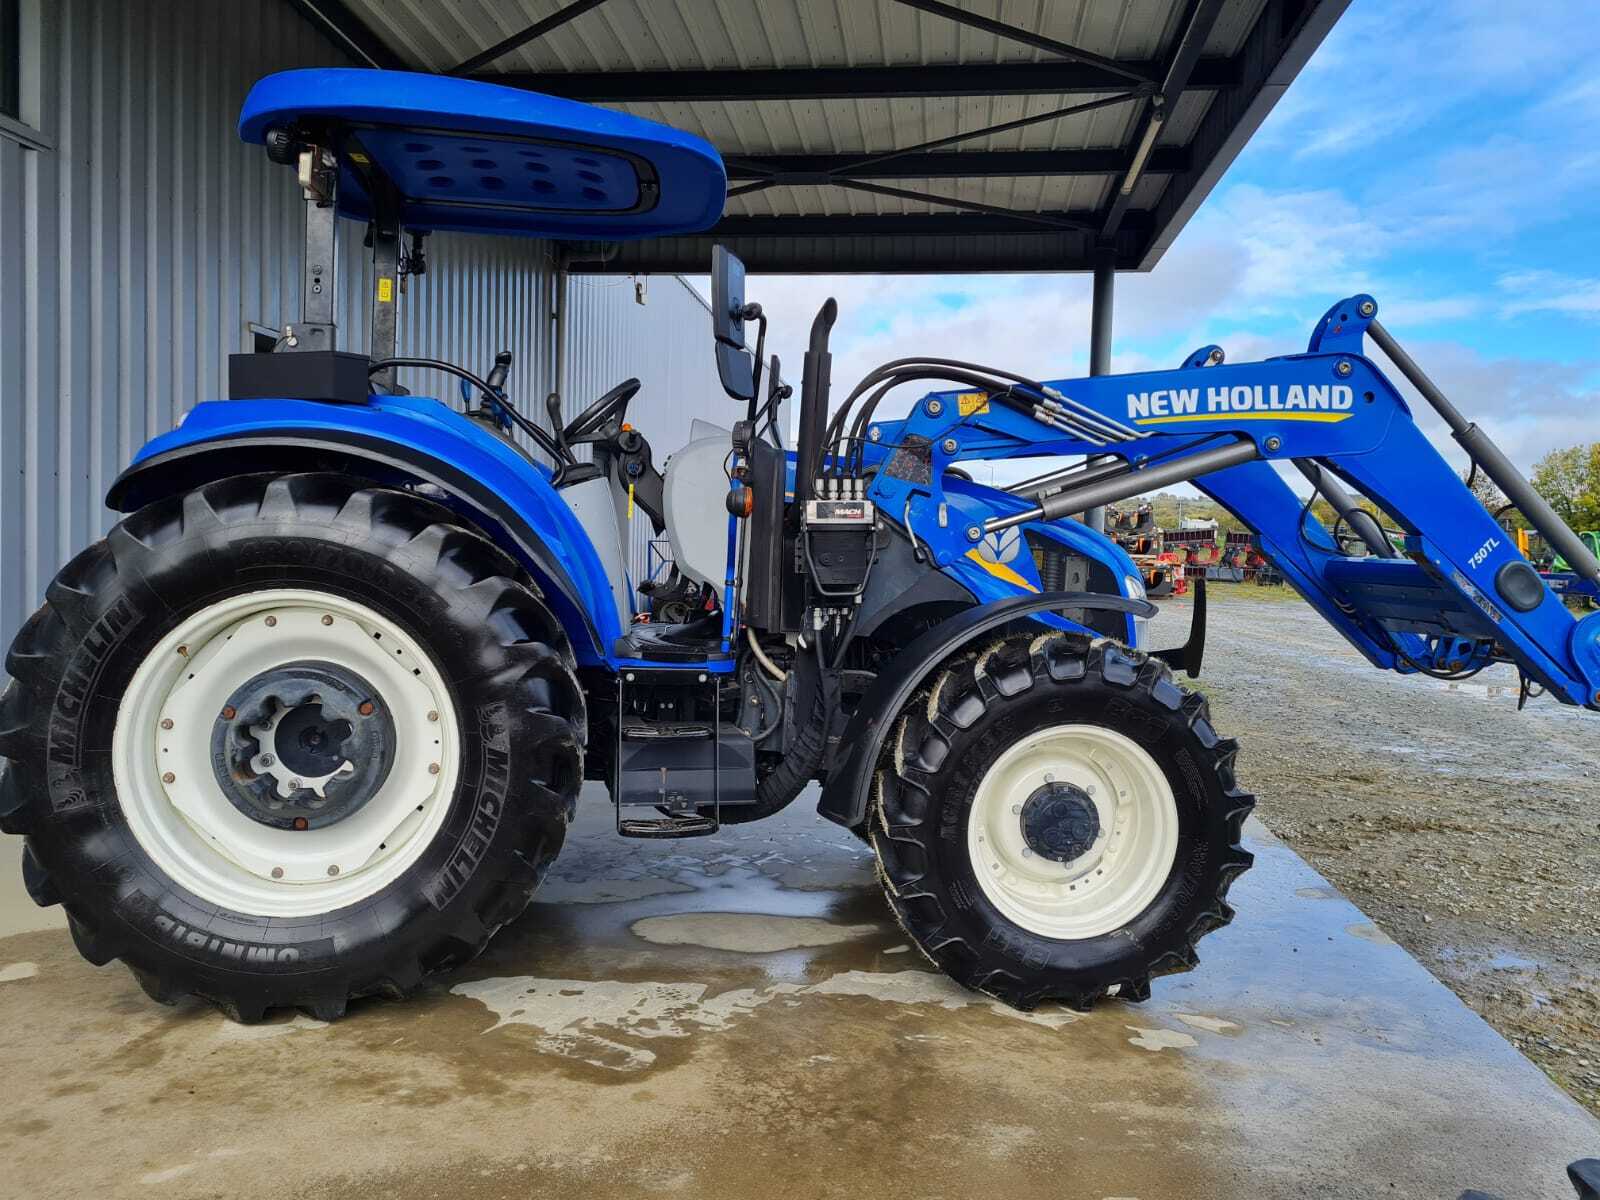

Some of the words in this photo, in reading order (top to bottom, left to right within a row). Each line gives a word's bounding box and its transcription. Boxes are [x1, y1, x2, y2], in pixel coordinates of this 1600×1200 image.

[1127, 388, 1199, 418] NEW
[1207, 384, 1354, 411] HOLLAND
[1467, 538, 1501, 570] 750TL
[50, 599, 138, 766] MICHELIN
[430, 747, 509, 908] MICHELIN
[153, 914, 300, 963] OMNIBIB
